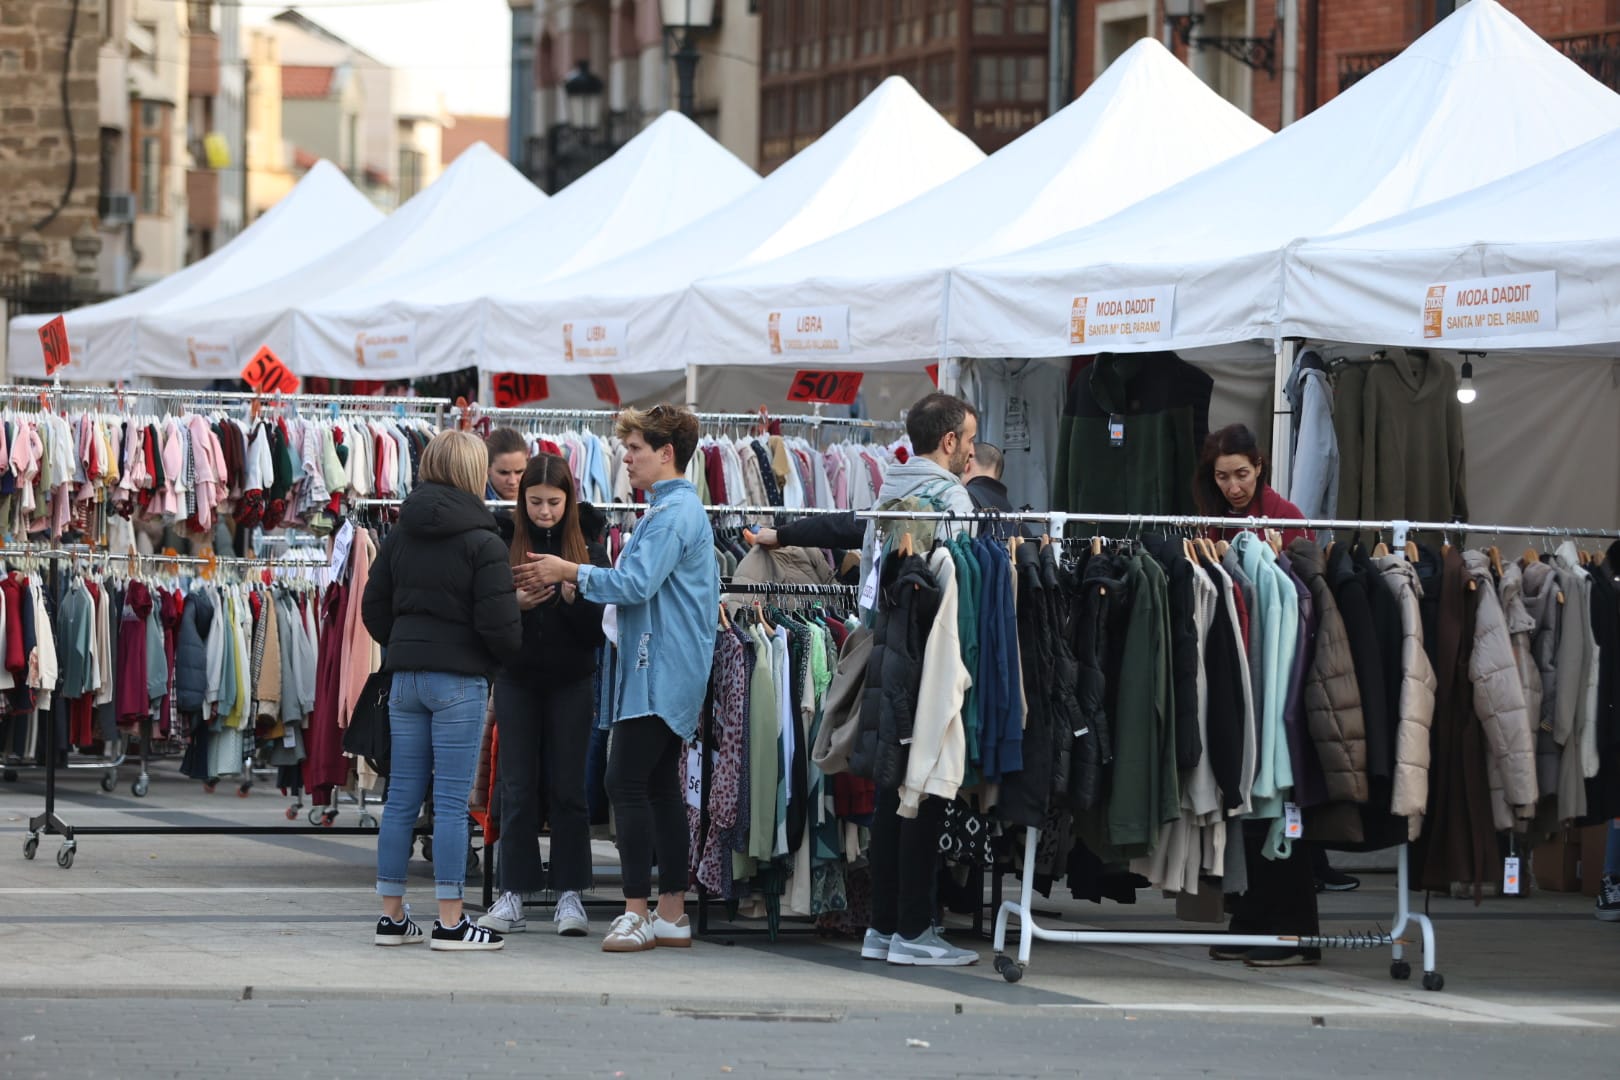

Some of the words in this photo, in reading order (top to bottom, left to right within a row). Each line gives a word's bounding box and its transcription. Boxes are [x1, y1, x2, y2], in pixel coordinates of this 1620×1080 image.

[1457, 288, 1488, 307] MODA
[1491, 284, 1531, 304] DADDIT
[1096, 300, 1123, 316] MODA
[1125, 298, 1156, 314] DADDIT
[1088, 323, 1108, 336] SANTA
[1120, 322, 1132, 334] DEL
[1446, 315, 1473, 329] SANTA
[1487, 312, 1504, 326] DEL
